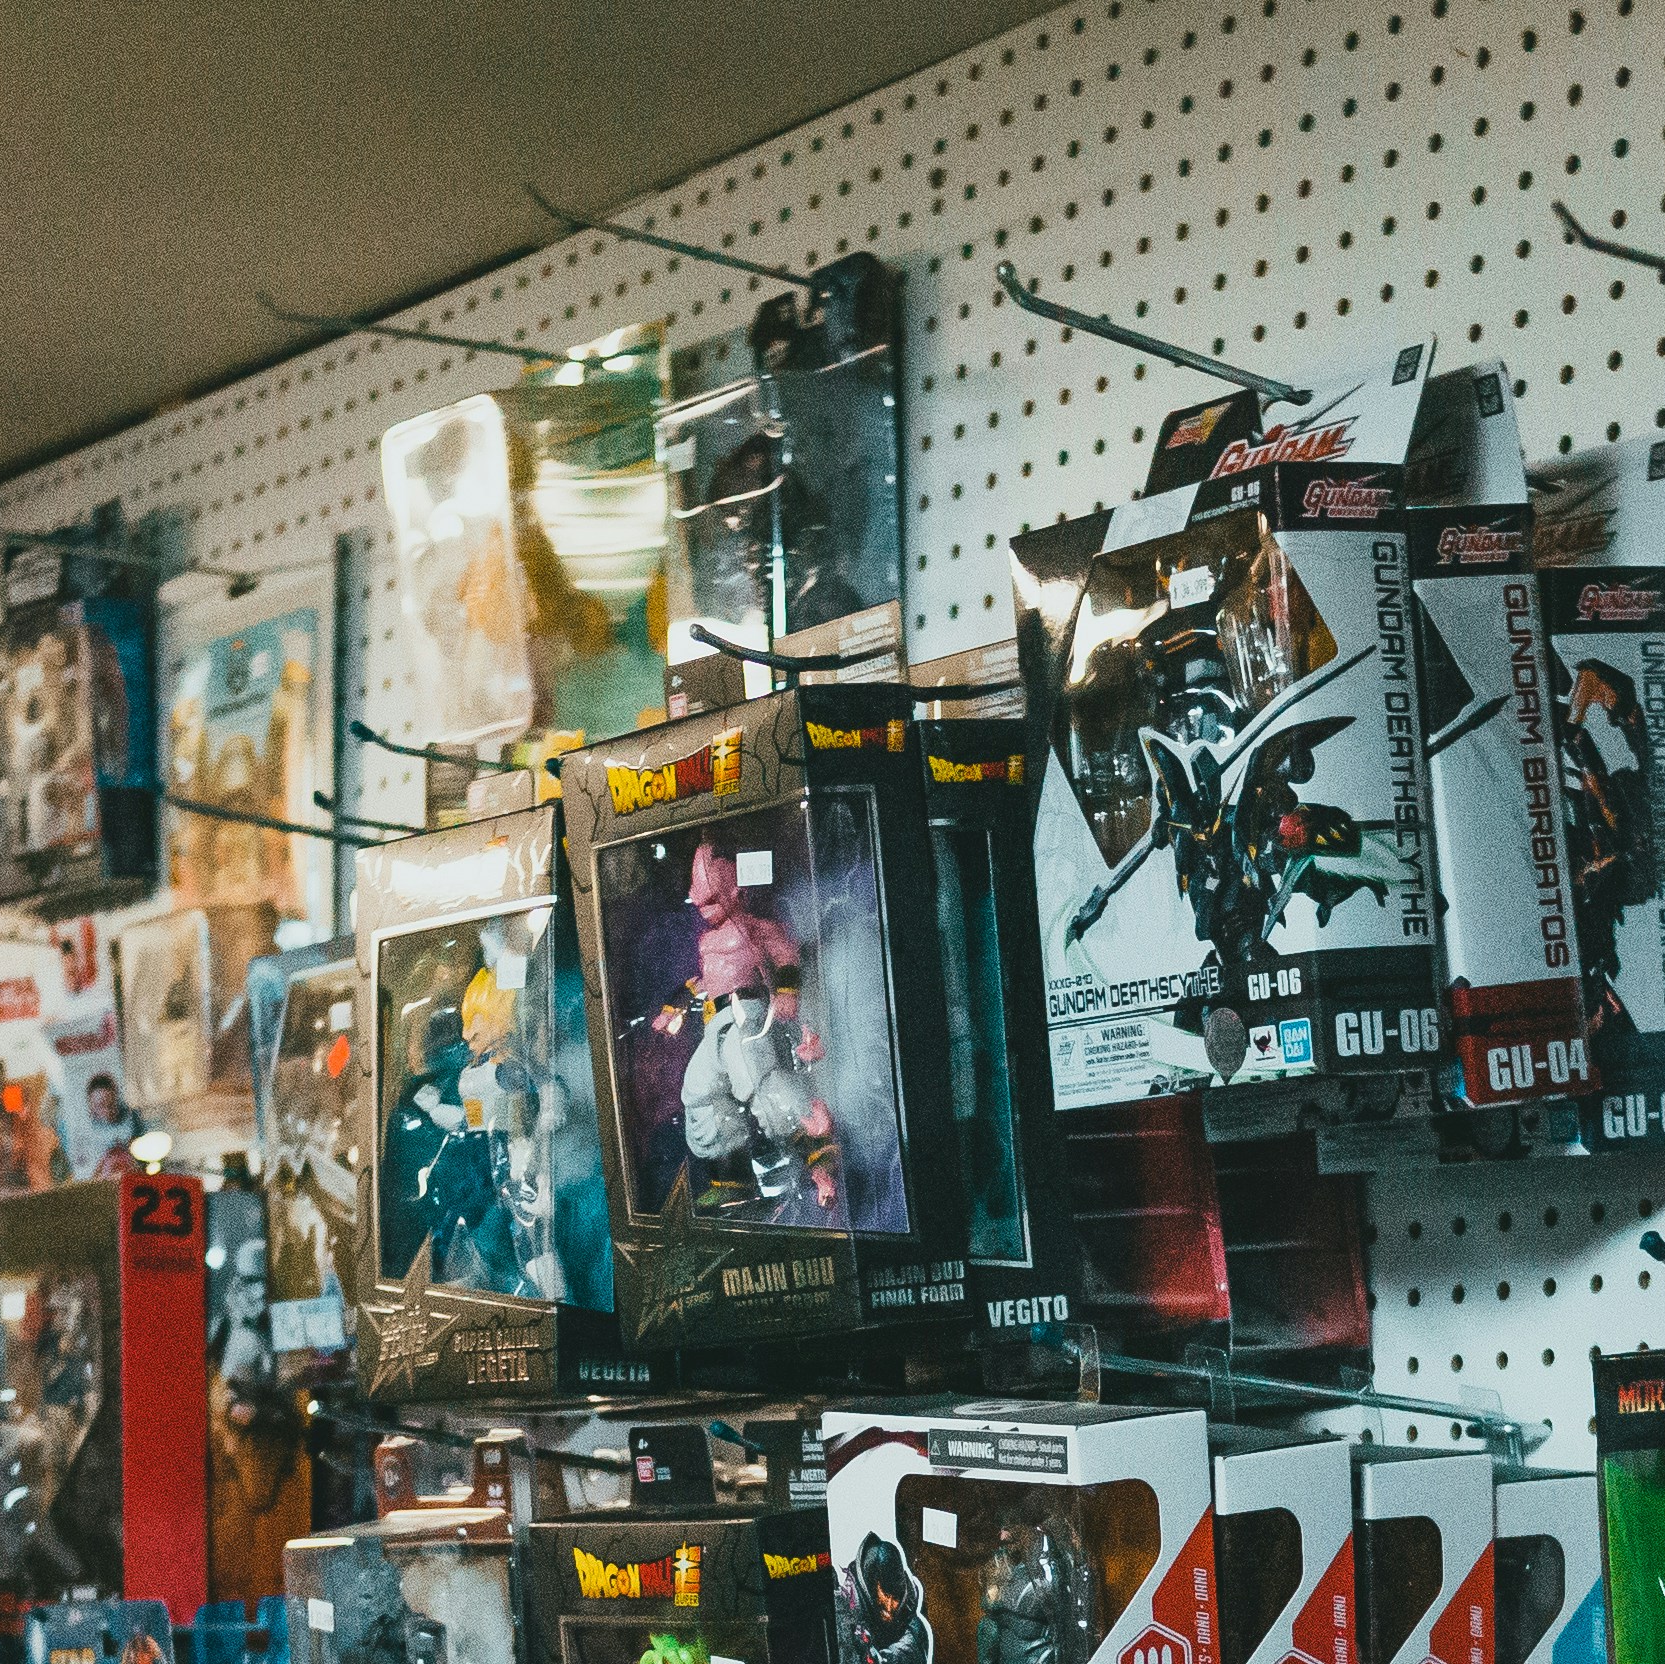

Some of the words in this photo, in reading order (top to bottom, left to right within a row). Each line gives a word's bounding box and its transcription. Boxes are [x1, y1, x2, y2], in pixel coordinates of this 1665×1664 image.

[1212, 412, 1356, 480] GUNDAM
[1303, 480, 1392, 516] GUNDAM
[1439, 525, 1525, 562] GUNDAM
[1371, 539, 1406, 681] GUNDAM
[1504, 582, 1543, 746] GUNDAM
[805, 719, 863, 748] DRAGON
[606, 760, 678, 815] DRAGON
[927, 752, 983, 783] DRAGON
[1385, 692, 1428, 938] DEATHSCYTHE
[1523, 752, 1570, 969] BARBATOS
[1050, 986, 1107, 1018] GUNDAM
[1109, 965, 1221, 1008] DEATHSCYTHE
[1247, 967, 1303, 1002] GU-06
[1335, 1007, 1440, 1059] GU-06
[1486, 1036, 1590, 1092] GU-04
[130, 1186, 193, 1237] 23
[722, 1263, 787, 1298] MAJIN
[793, 1256, 835, 1287] BUU
[871, 1286, 917, 1308] FINAL
[988, 1295, 1069, 1328] VEGITO
[573, 1546, 641, 1599] DRAGON
[762, 1552, 818, 1580] DRAGON
